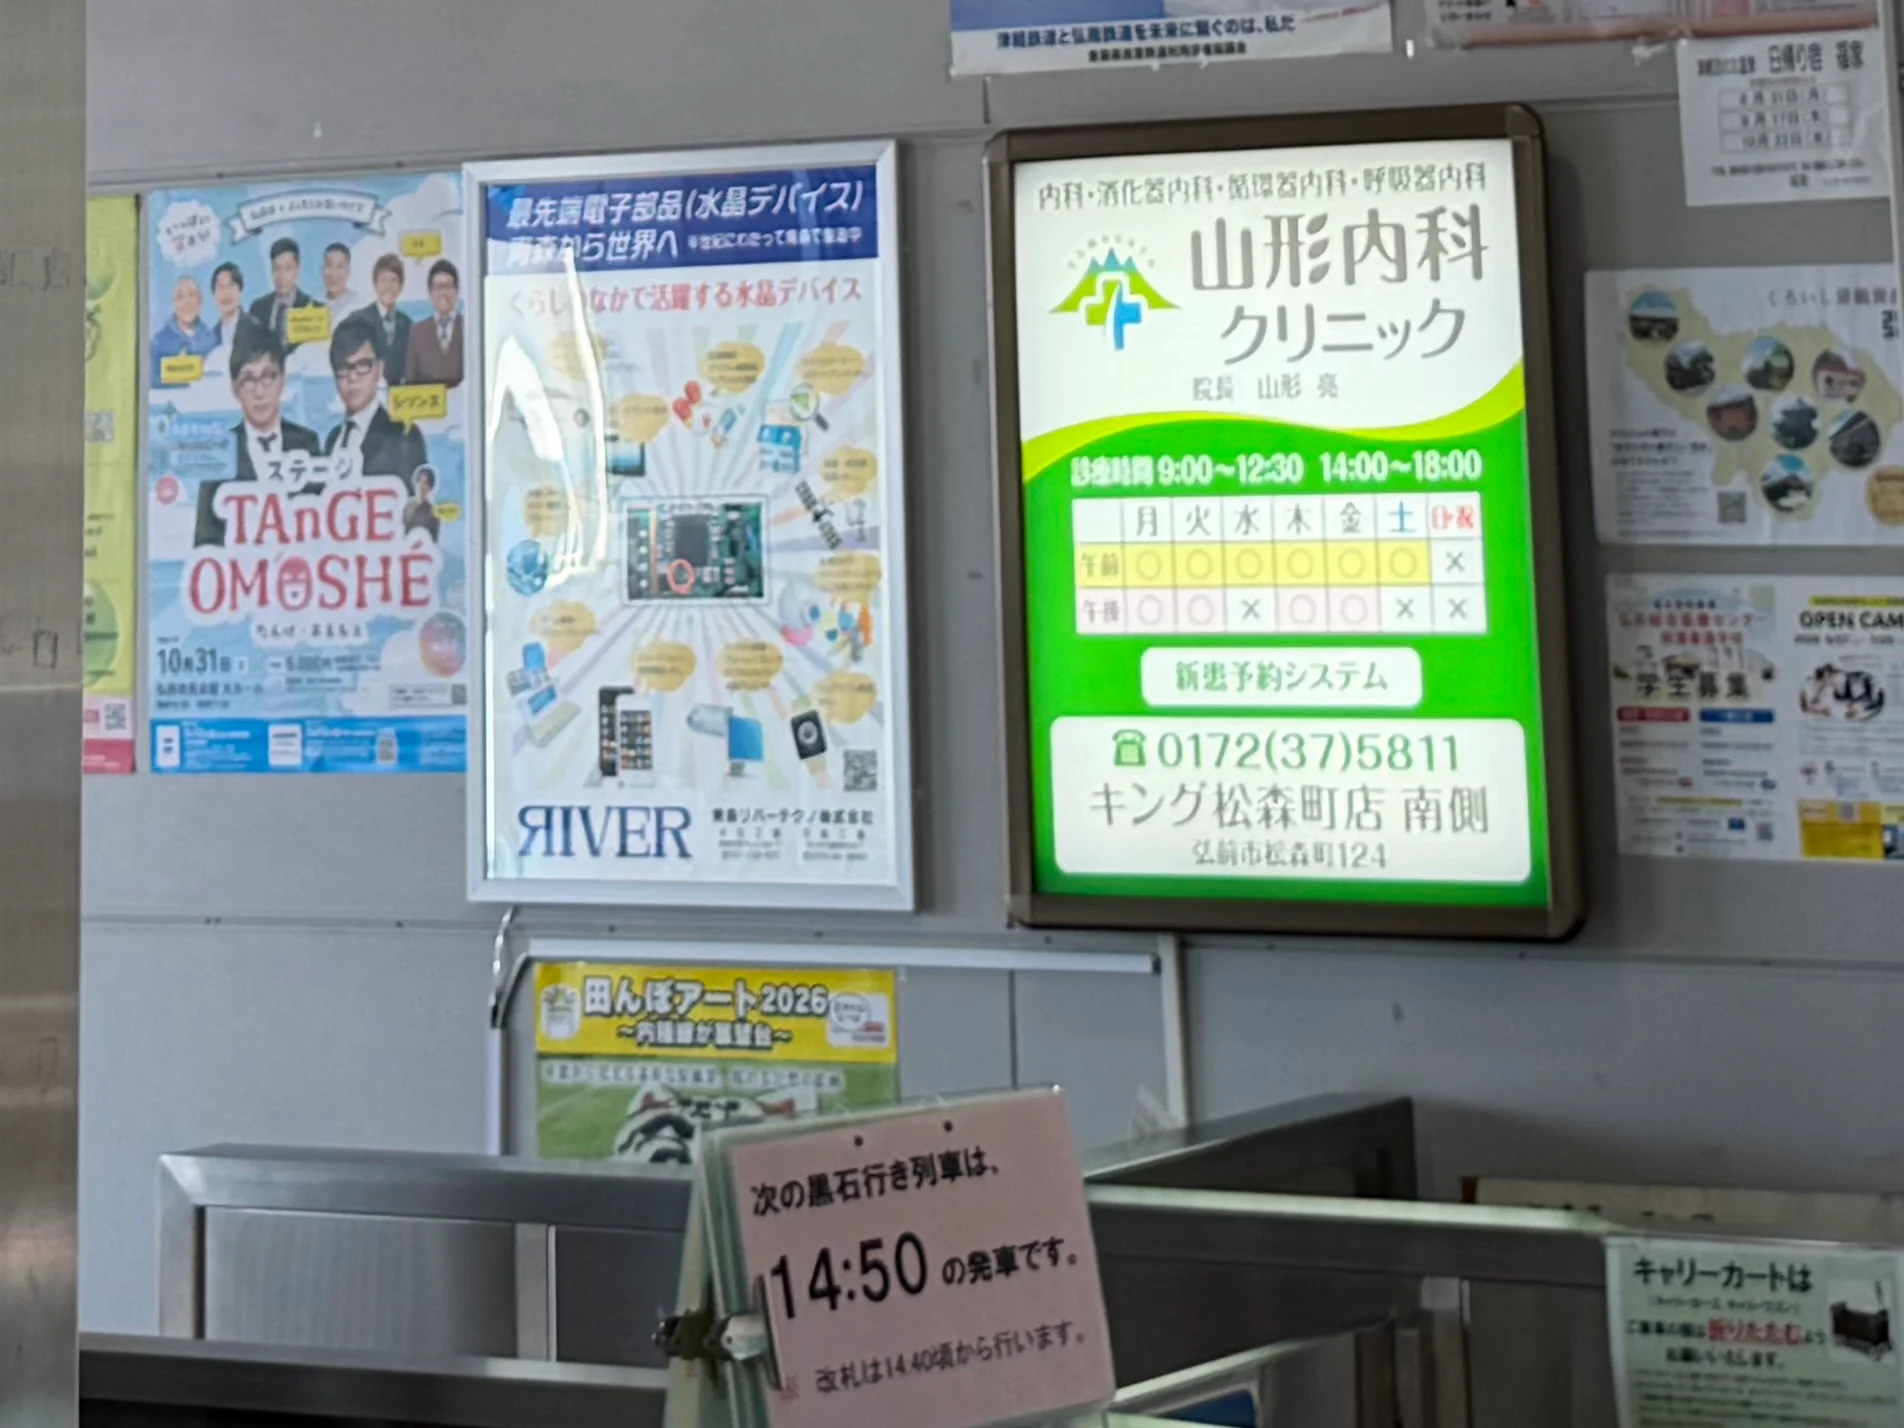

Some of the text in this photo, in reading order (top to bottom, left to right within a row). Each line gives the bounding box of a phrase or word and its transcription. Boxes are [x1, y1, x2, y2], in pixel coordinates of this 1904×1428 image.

[1038, 161, 1488, 210] 内科・消化器内科・循環器内科・呼吸器内科
[1190, 203, 1489, 291] 山形内科
[1219, 299, 1467, 366] クリニック
[1192, 372, 1339, 403] 院長 山形 亮
[264, 457, 355, 484] ステージ
[1135, 505, 1159, 537] 月
[1185, 505, 1212, 536] 火
[1234, 504, 1261, 536] 水
[1285, 504, 1313, 535] 木
[1338, 501, 1364, 535] 金
[1388, 501, 1416, 534] 土
[1080, 551, 1121, 578] 午前
[1799, 610, 1855, 631] OPEN
[1175, 660, 1389, 692] 新患予約システム
[1156, 730, 1460, 773] 0172(37)5811
[1089, 781, 1489, 834] キング松森町店 南側
[582, 974, 830, 1018] 田んぼアート2026
[751, 1145, 999, 1217] 次の黒石行き列車は、
[770, 1230, 1078, 1320] 14:50 の発車です。
[1632, 1255, 1814, 1293] キャリーカートは
